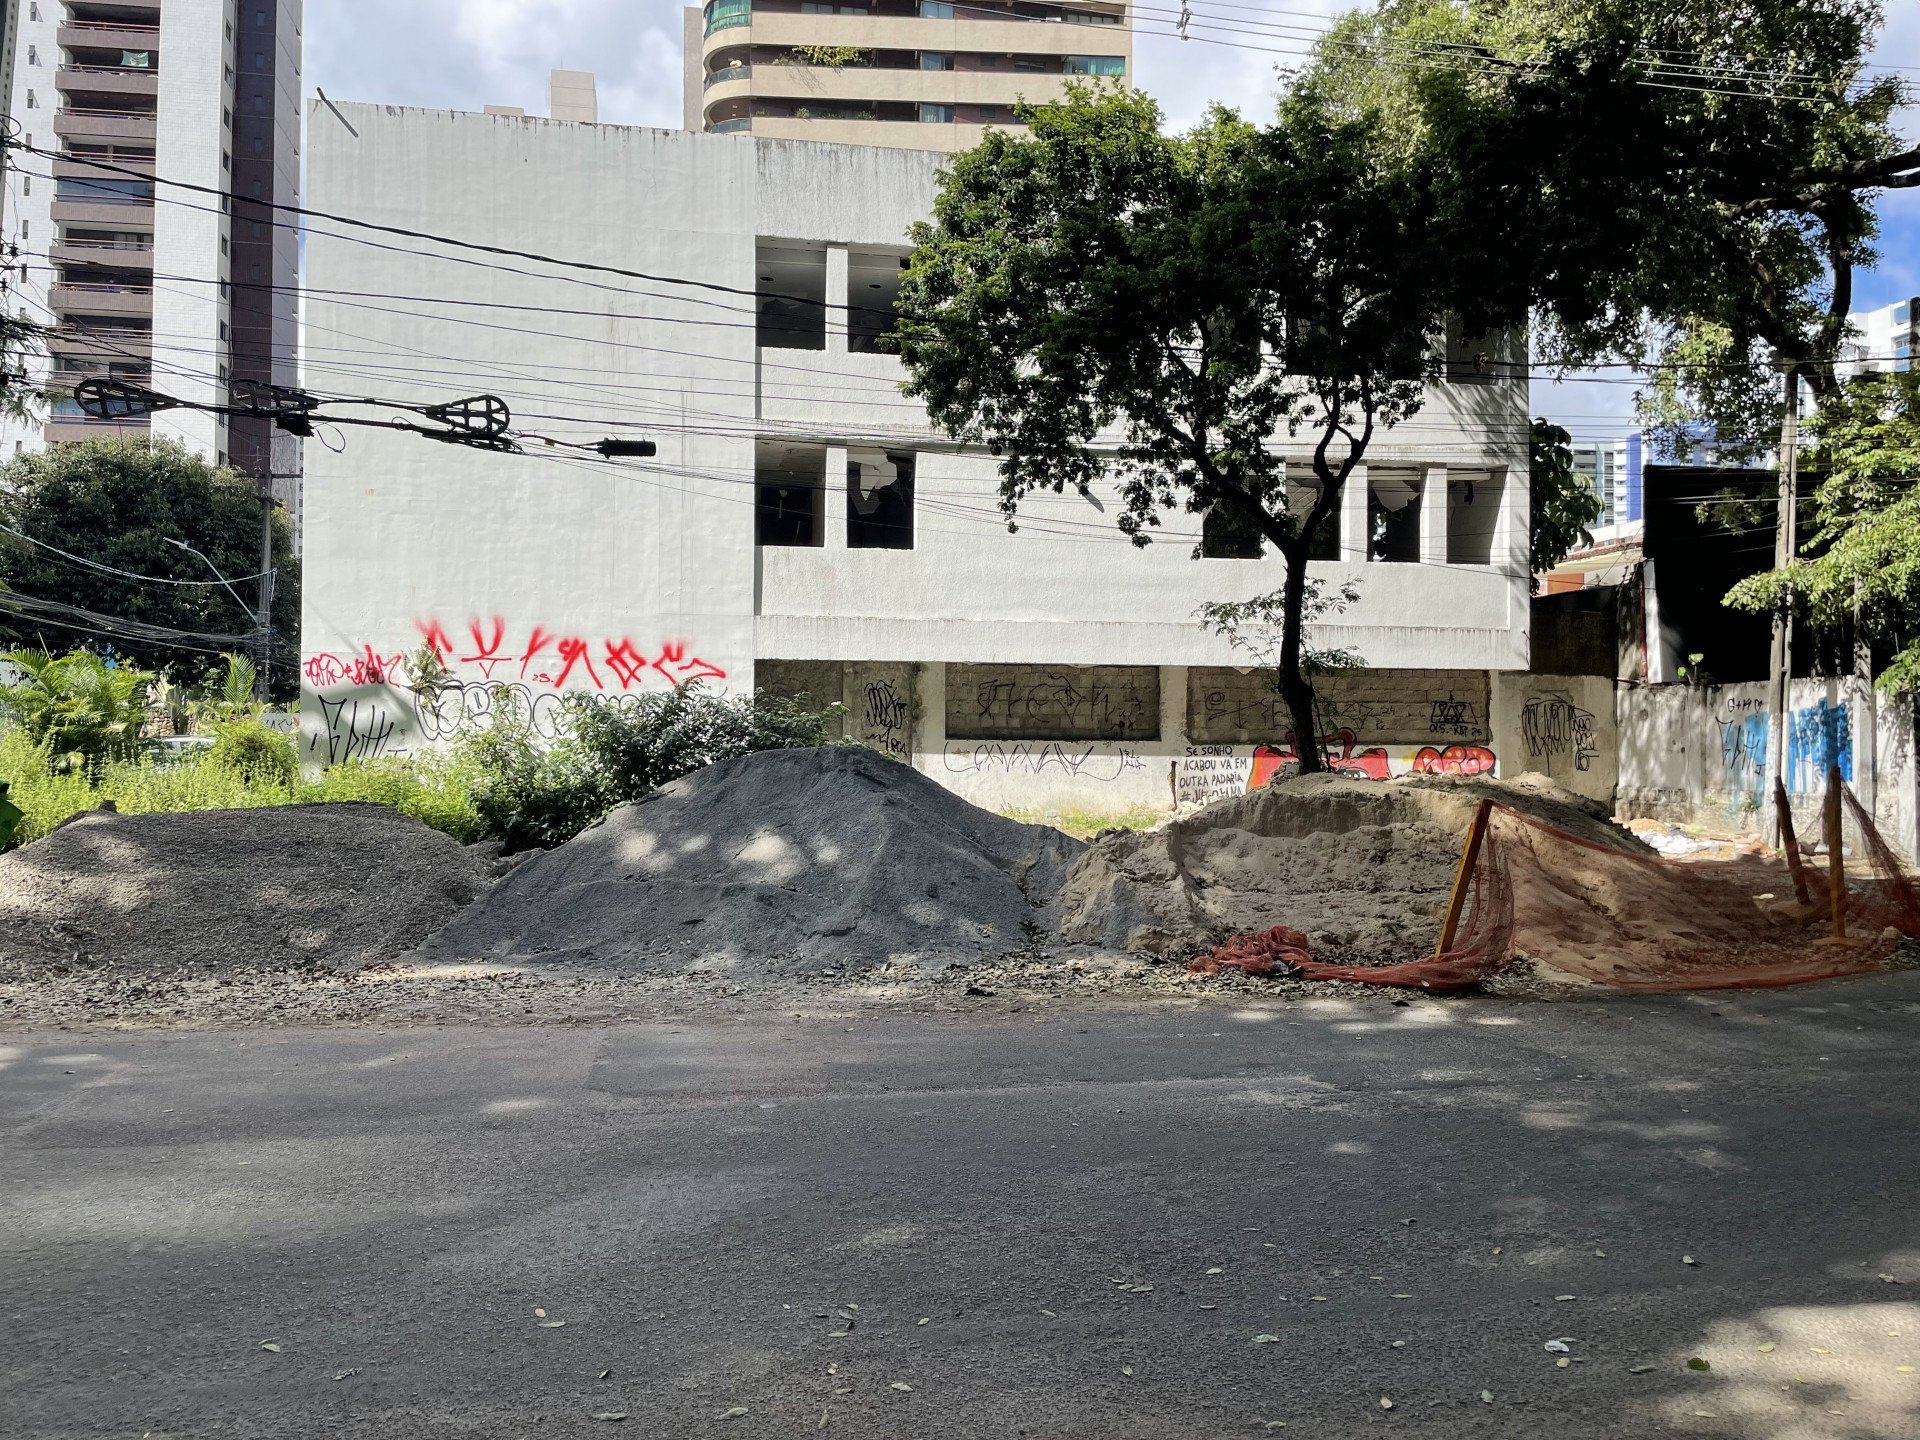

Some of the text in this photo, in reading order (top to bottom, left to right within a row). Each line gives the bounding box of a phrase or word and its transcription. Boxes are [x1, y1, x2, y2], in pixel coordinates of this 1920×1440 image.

[1185, 747, 1198, 757] SE
[1184, 759, 1216, 771] ACABOU
[1235, 758, 1247, 769] EM
[1180, 772, 1244, 788] OUTRA PADARIA
